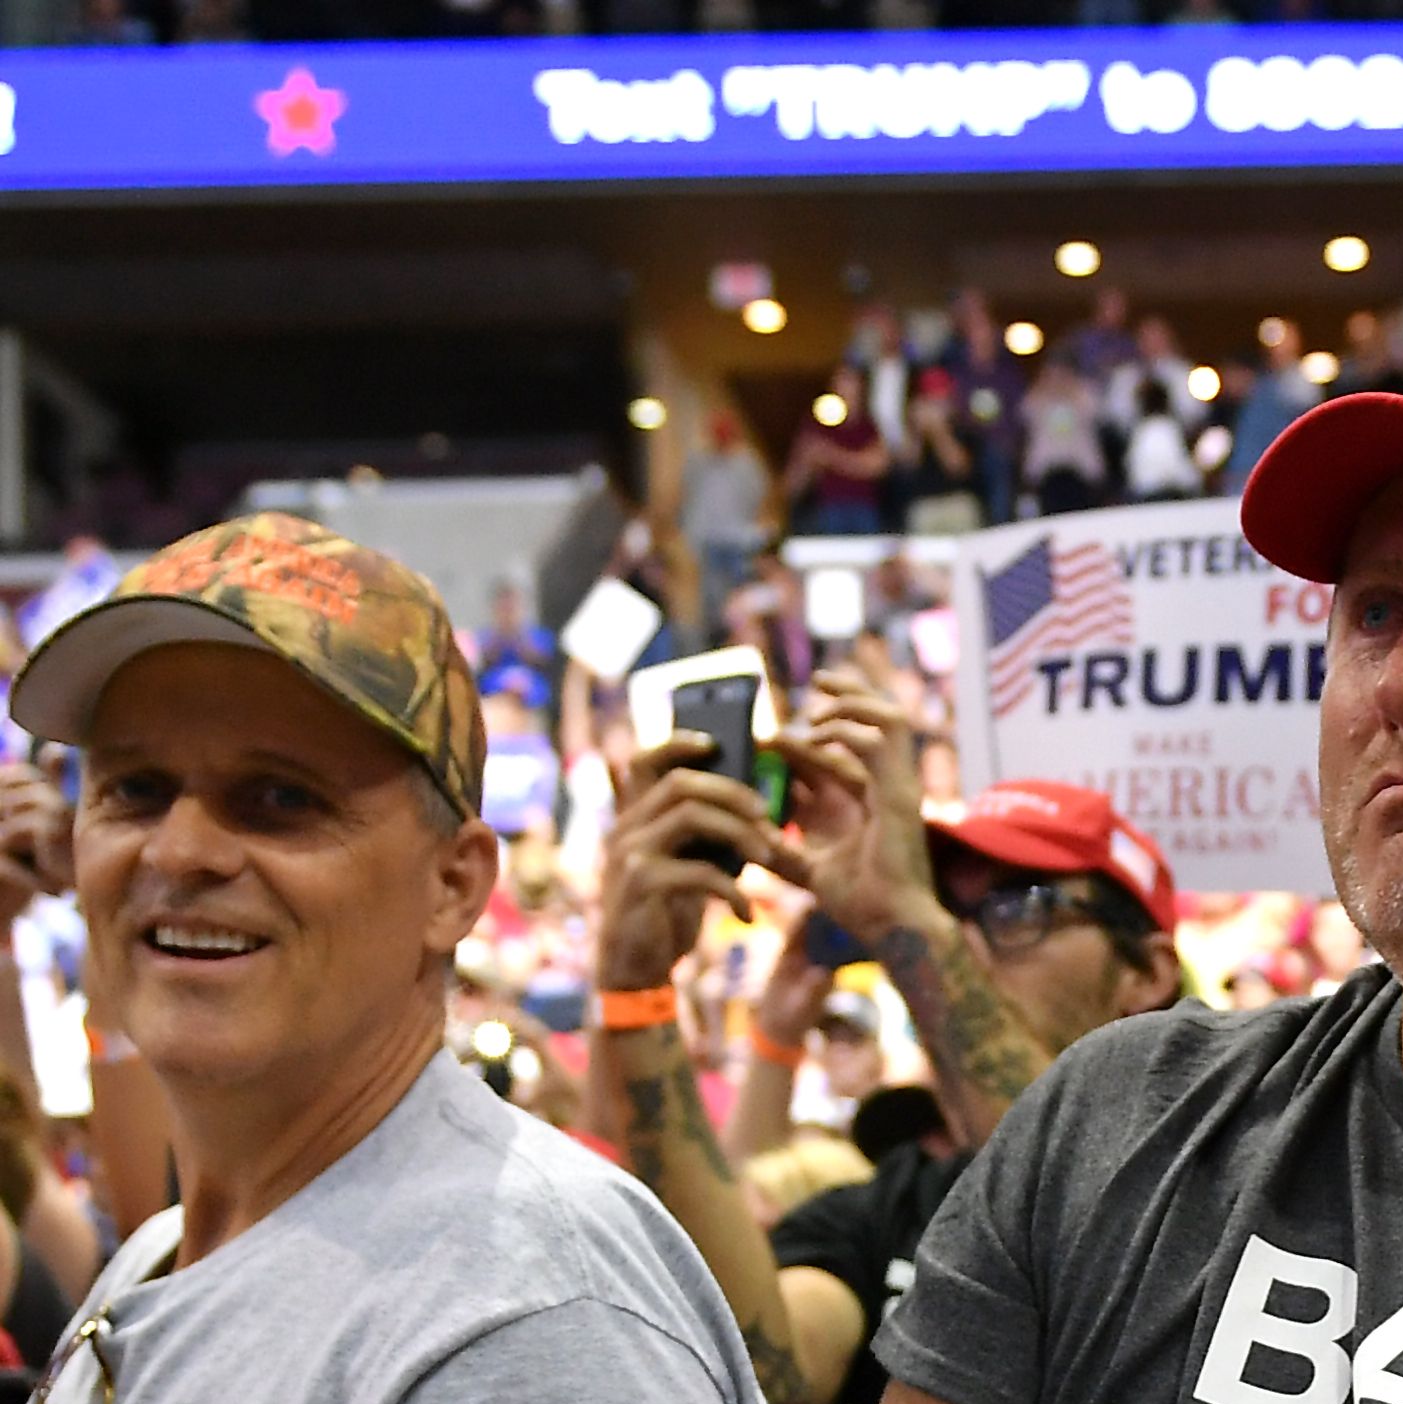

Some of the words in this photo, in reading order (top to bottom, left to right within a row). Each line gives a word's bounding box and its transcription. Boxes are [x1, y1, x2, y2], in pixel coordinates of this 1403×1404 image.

[534, 69, 714, 143] Text
[1100, 62, 1196, 133] to
[1116, 533, 1274, 580] VETER
[1264, 580, 1333, 627] FO
